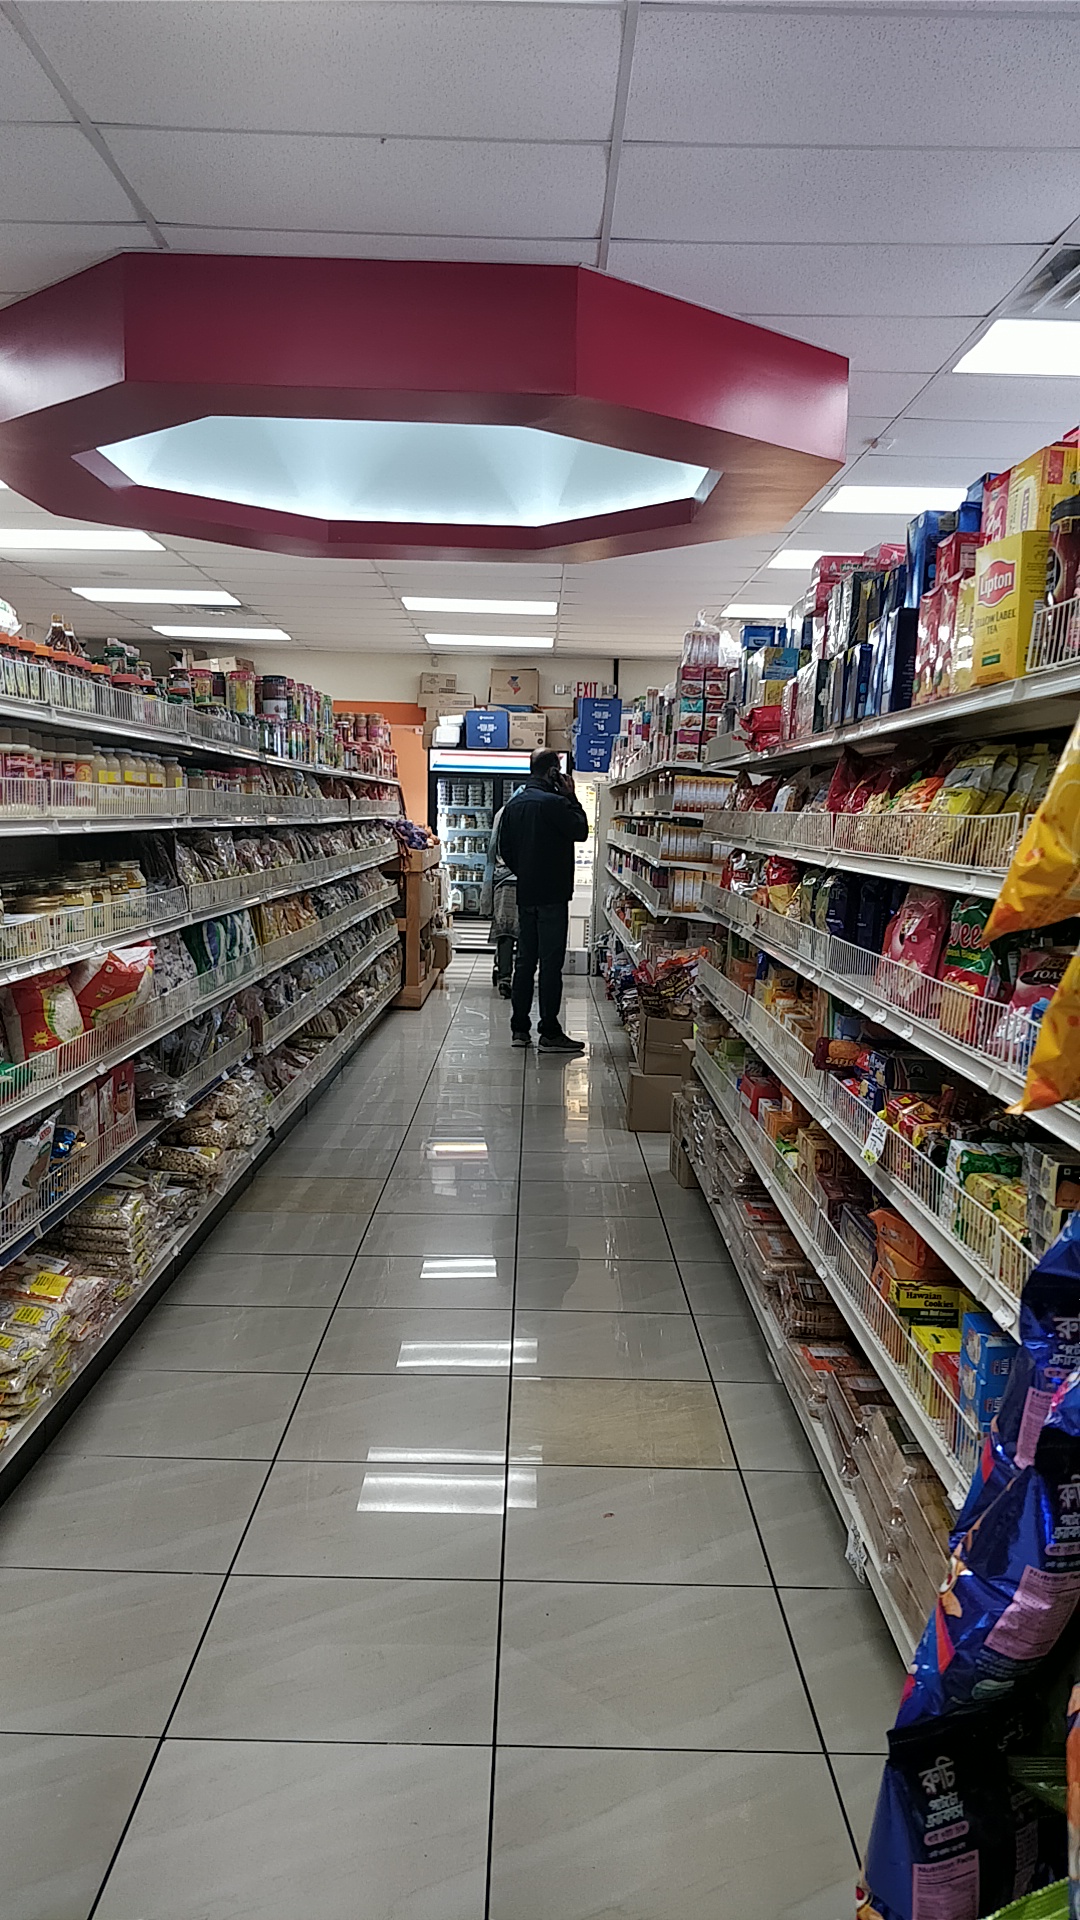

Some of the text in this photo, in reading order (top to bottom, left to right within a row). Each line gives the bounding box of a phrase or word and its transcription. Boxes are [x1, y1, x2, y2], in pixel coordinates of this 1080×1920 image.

[980, 571, 1013, 598] Lipton
[996, 608, 1016, 622] LABEL
[987, 624, 998, 635] TEA
[577, 682, 598, 698] EXIT
[924, 1300, 954, 1308] Cookies
[918, 1755, 956, 1795] রুচি
[918, 1854, 976, 1873] Nutrition Facts
